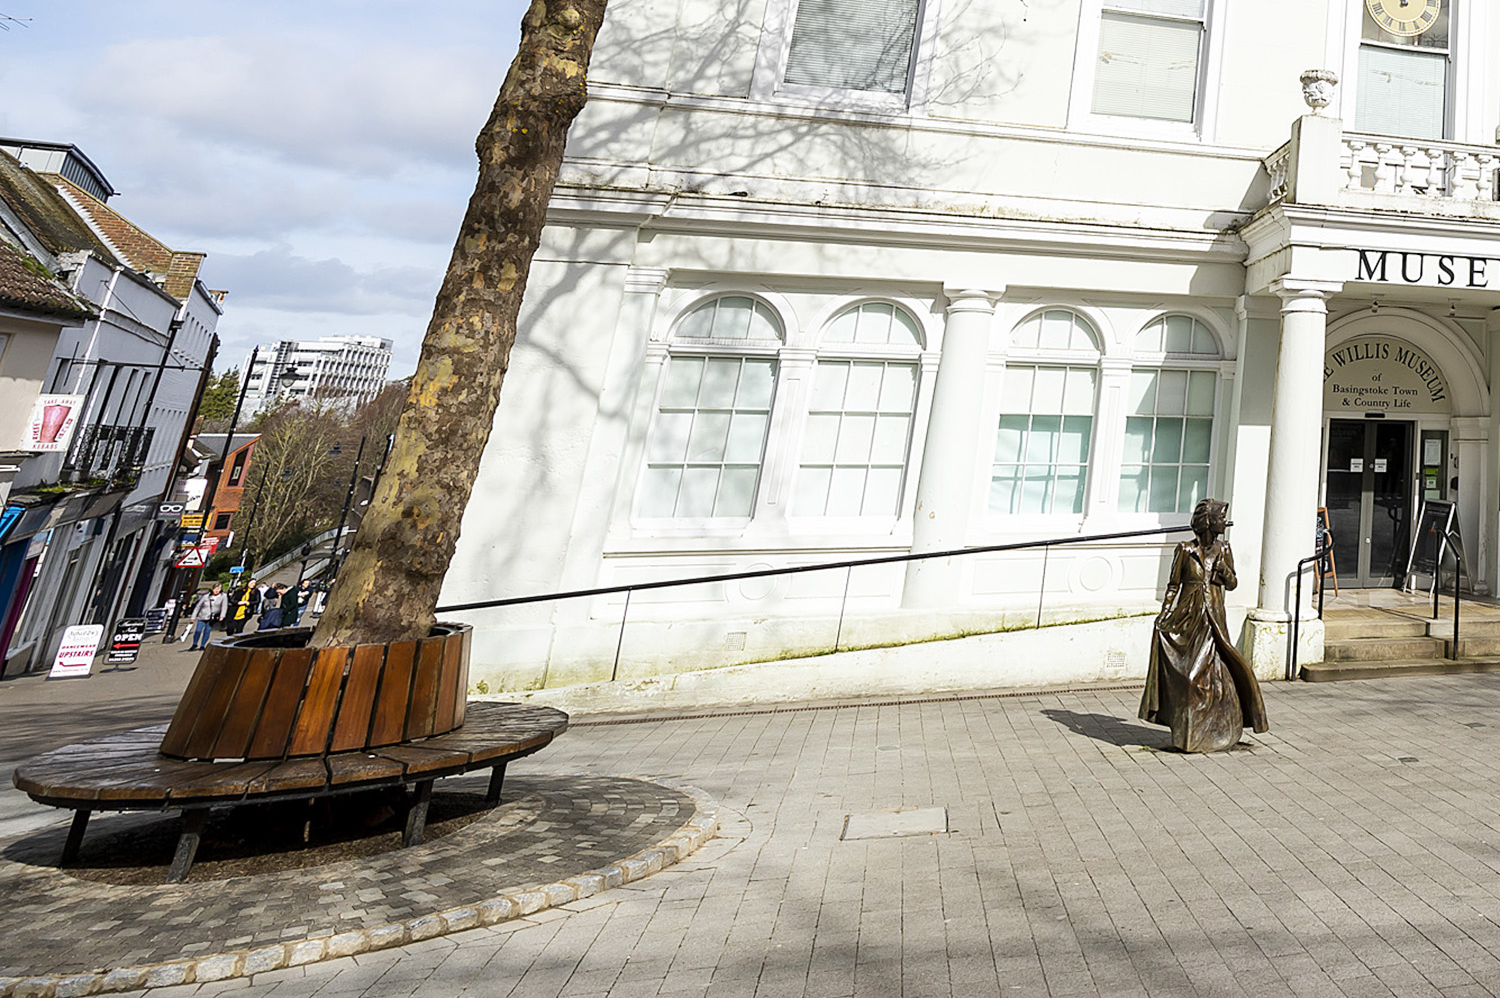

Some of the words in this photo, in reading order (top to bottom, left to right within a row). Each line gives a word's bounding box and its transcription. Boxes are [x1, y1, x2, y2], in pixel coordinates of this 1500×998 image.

[1331, 343, 1390, 368] WILLIS
[1394, 347, 1446, 403] MUSEUM
[1371, 373, 1383, 382] of
[1332, 384, 1389, 397] Basingstoke
[1391, 386, 1418, 396] Town
[1342, 398, 1351, 406] &
[1354, 397, 1391, 409] Country
[1393, 399, 1412, 408] Life
[114, 633, 143, 641] OPEN
[58, 650, 94, 658] UPSTAIRS
